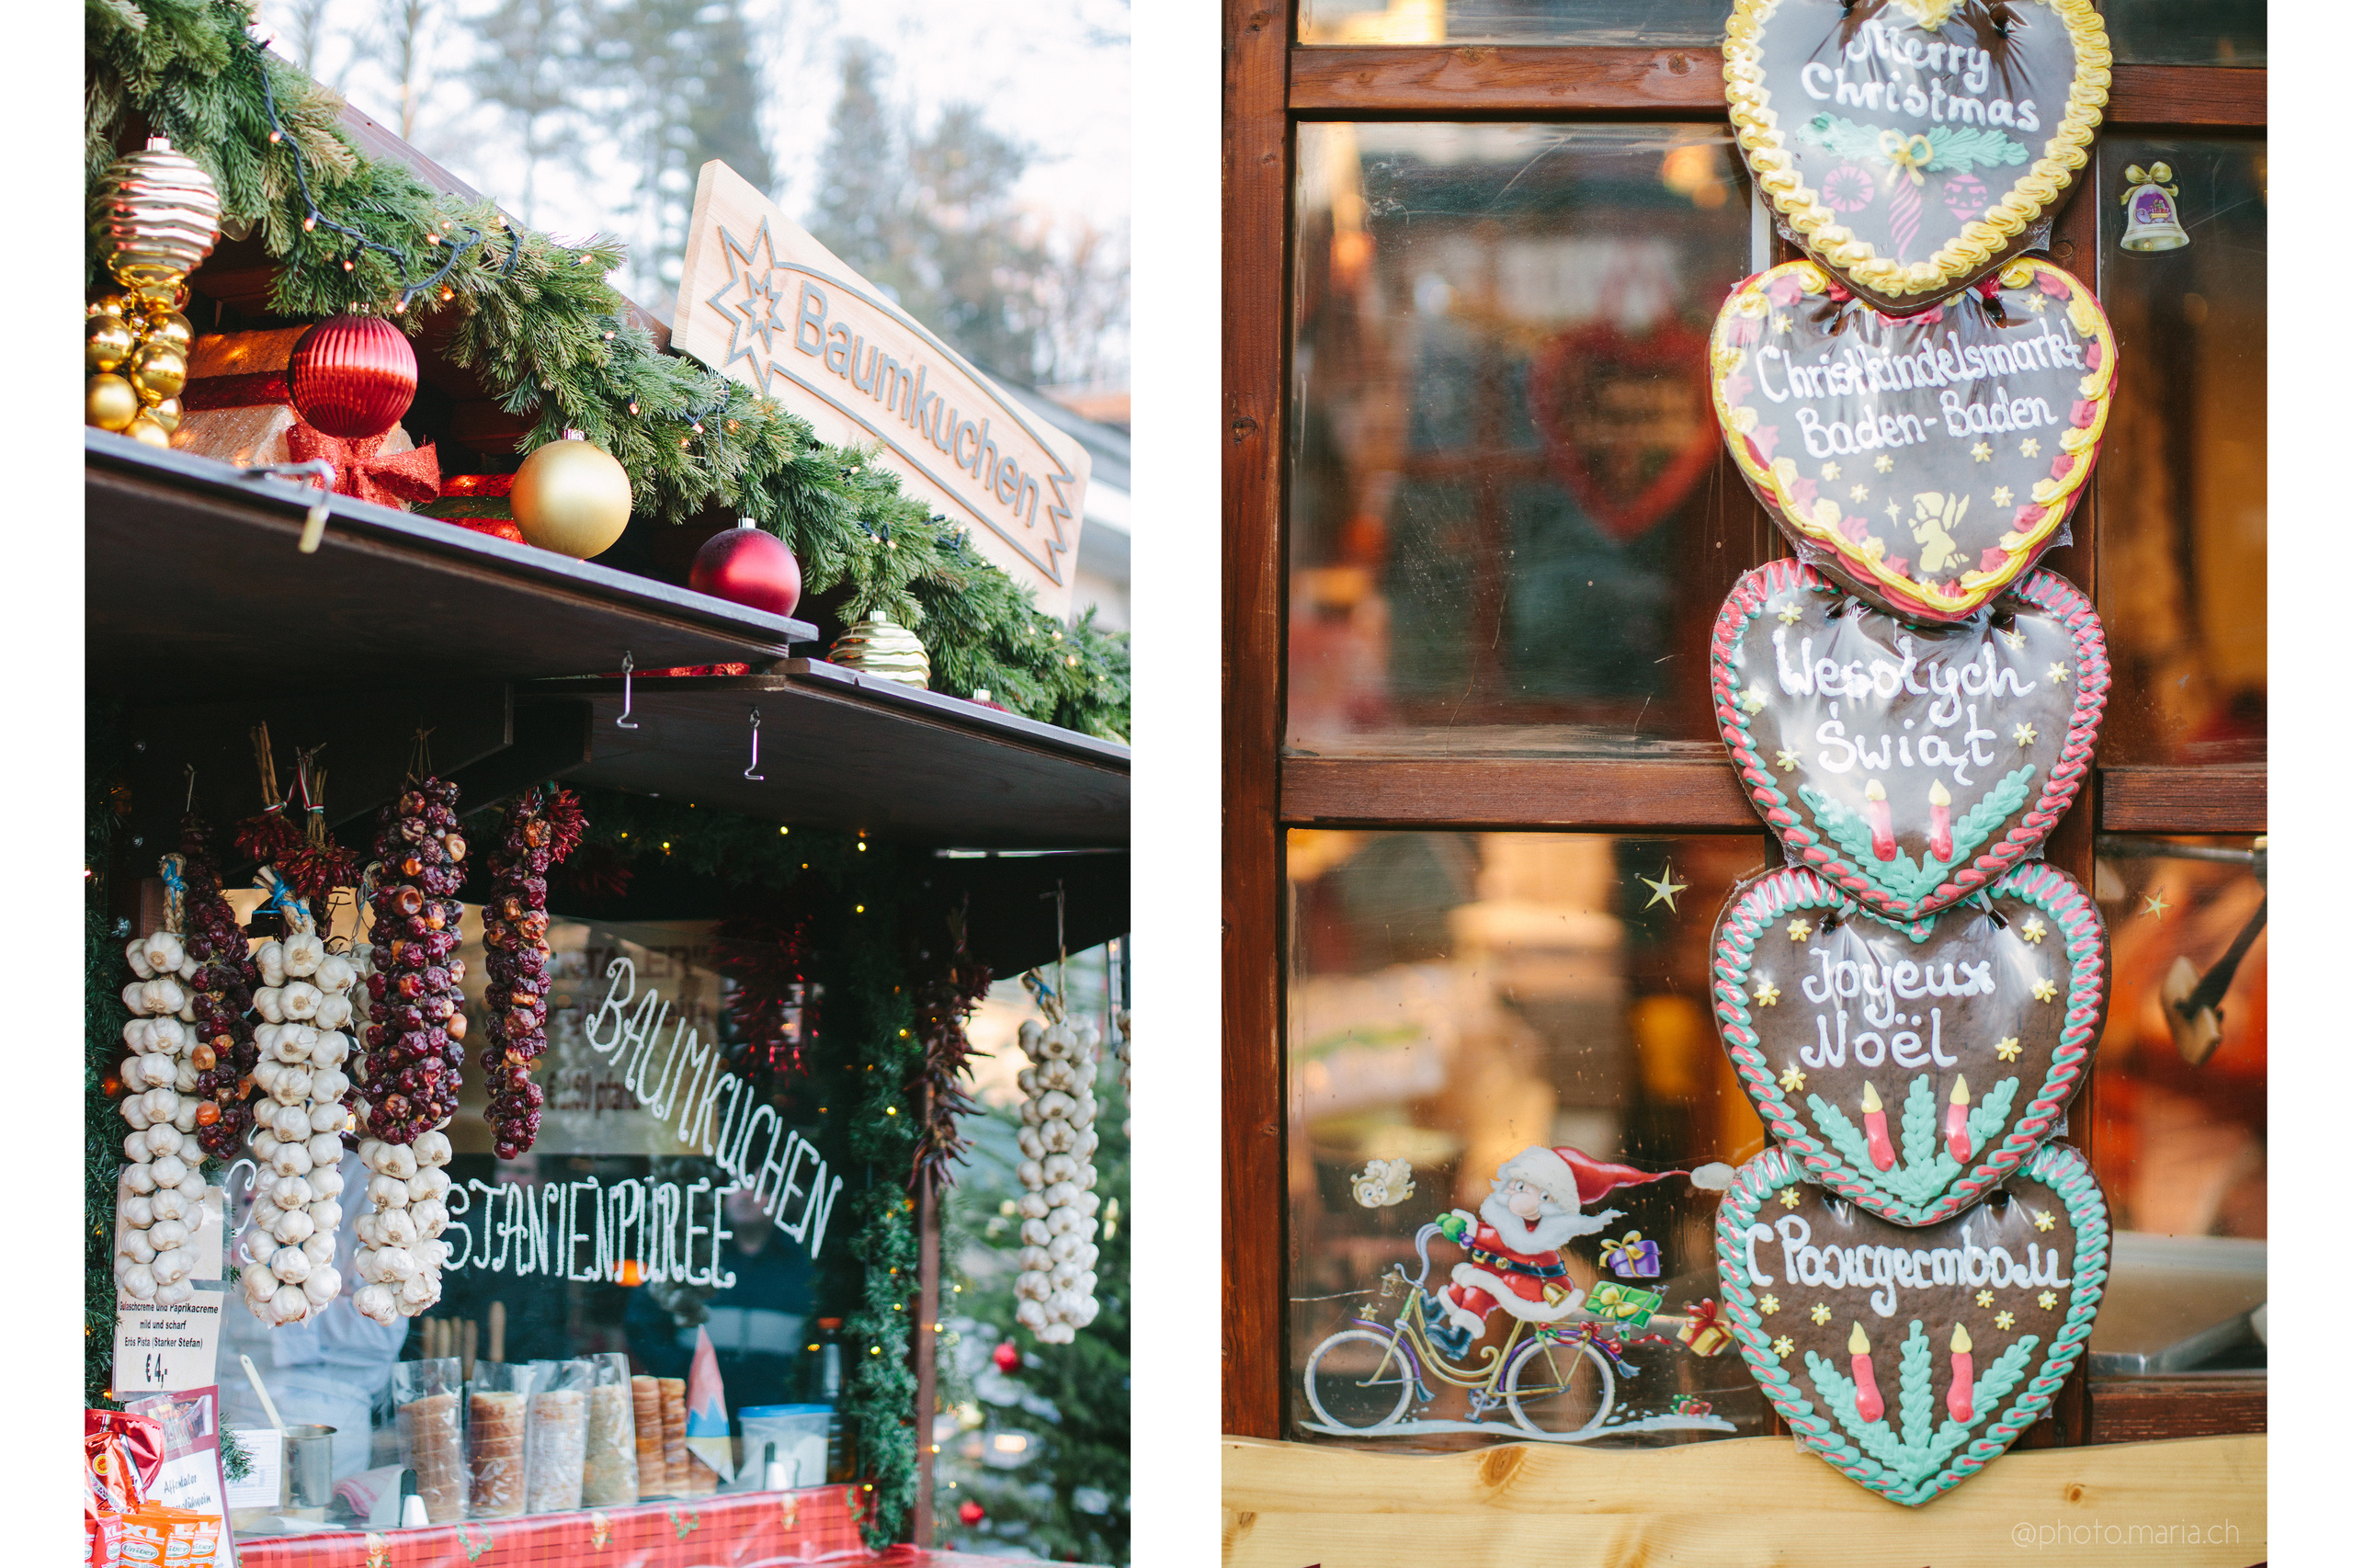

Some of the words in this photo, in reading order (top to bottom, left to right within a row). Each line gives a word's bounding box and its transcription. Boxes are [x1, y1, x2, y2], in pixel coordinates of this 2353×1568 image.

[1846, 17, 1991, 94] Merry
[1801, 61, 2041, 132] Christmas
[1756, 316, 2086, 403] Christkindelsmarkt
[795, 278, 1041, 528] Baumkuchen
[1794, 386, 2059, 459] Baden-Baden
[1770, 629, 2037, 728] Wesołych
[1814, 701, 1998, 787] Świąt
[1801, 946, 1996, 1029] Joyeux
[1799, 1006, 1959, 1069] Noël
[585, 956, 843, 1261] BAUMKUCHEN
[441, 1176, 740, 1288] STANIENPÜREE
[137, 1336, 151, 1346] Pista
[152, 1336, 176, 1349] (Starker
[177, 1337, 203, 1349] Stefan)
[139, 1319, 152, 1329] mild
[153, 1319, 165, 1330] und
[165, 1320, 188, 1330] scharf
[169, 1302, 219, 1314] Paprikacreme
[145, 1353, 152, 1383] €
[121, 1521, 165, 1542] XL
